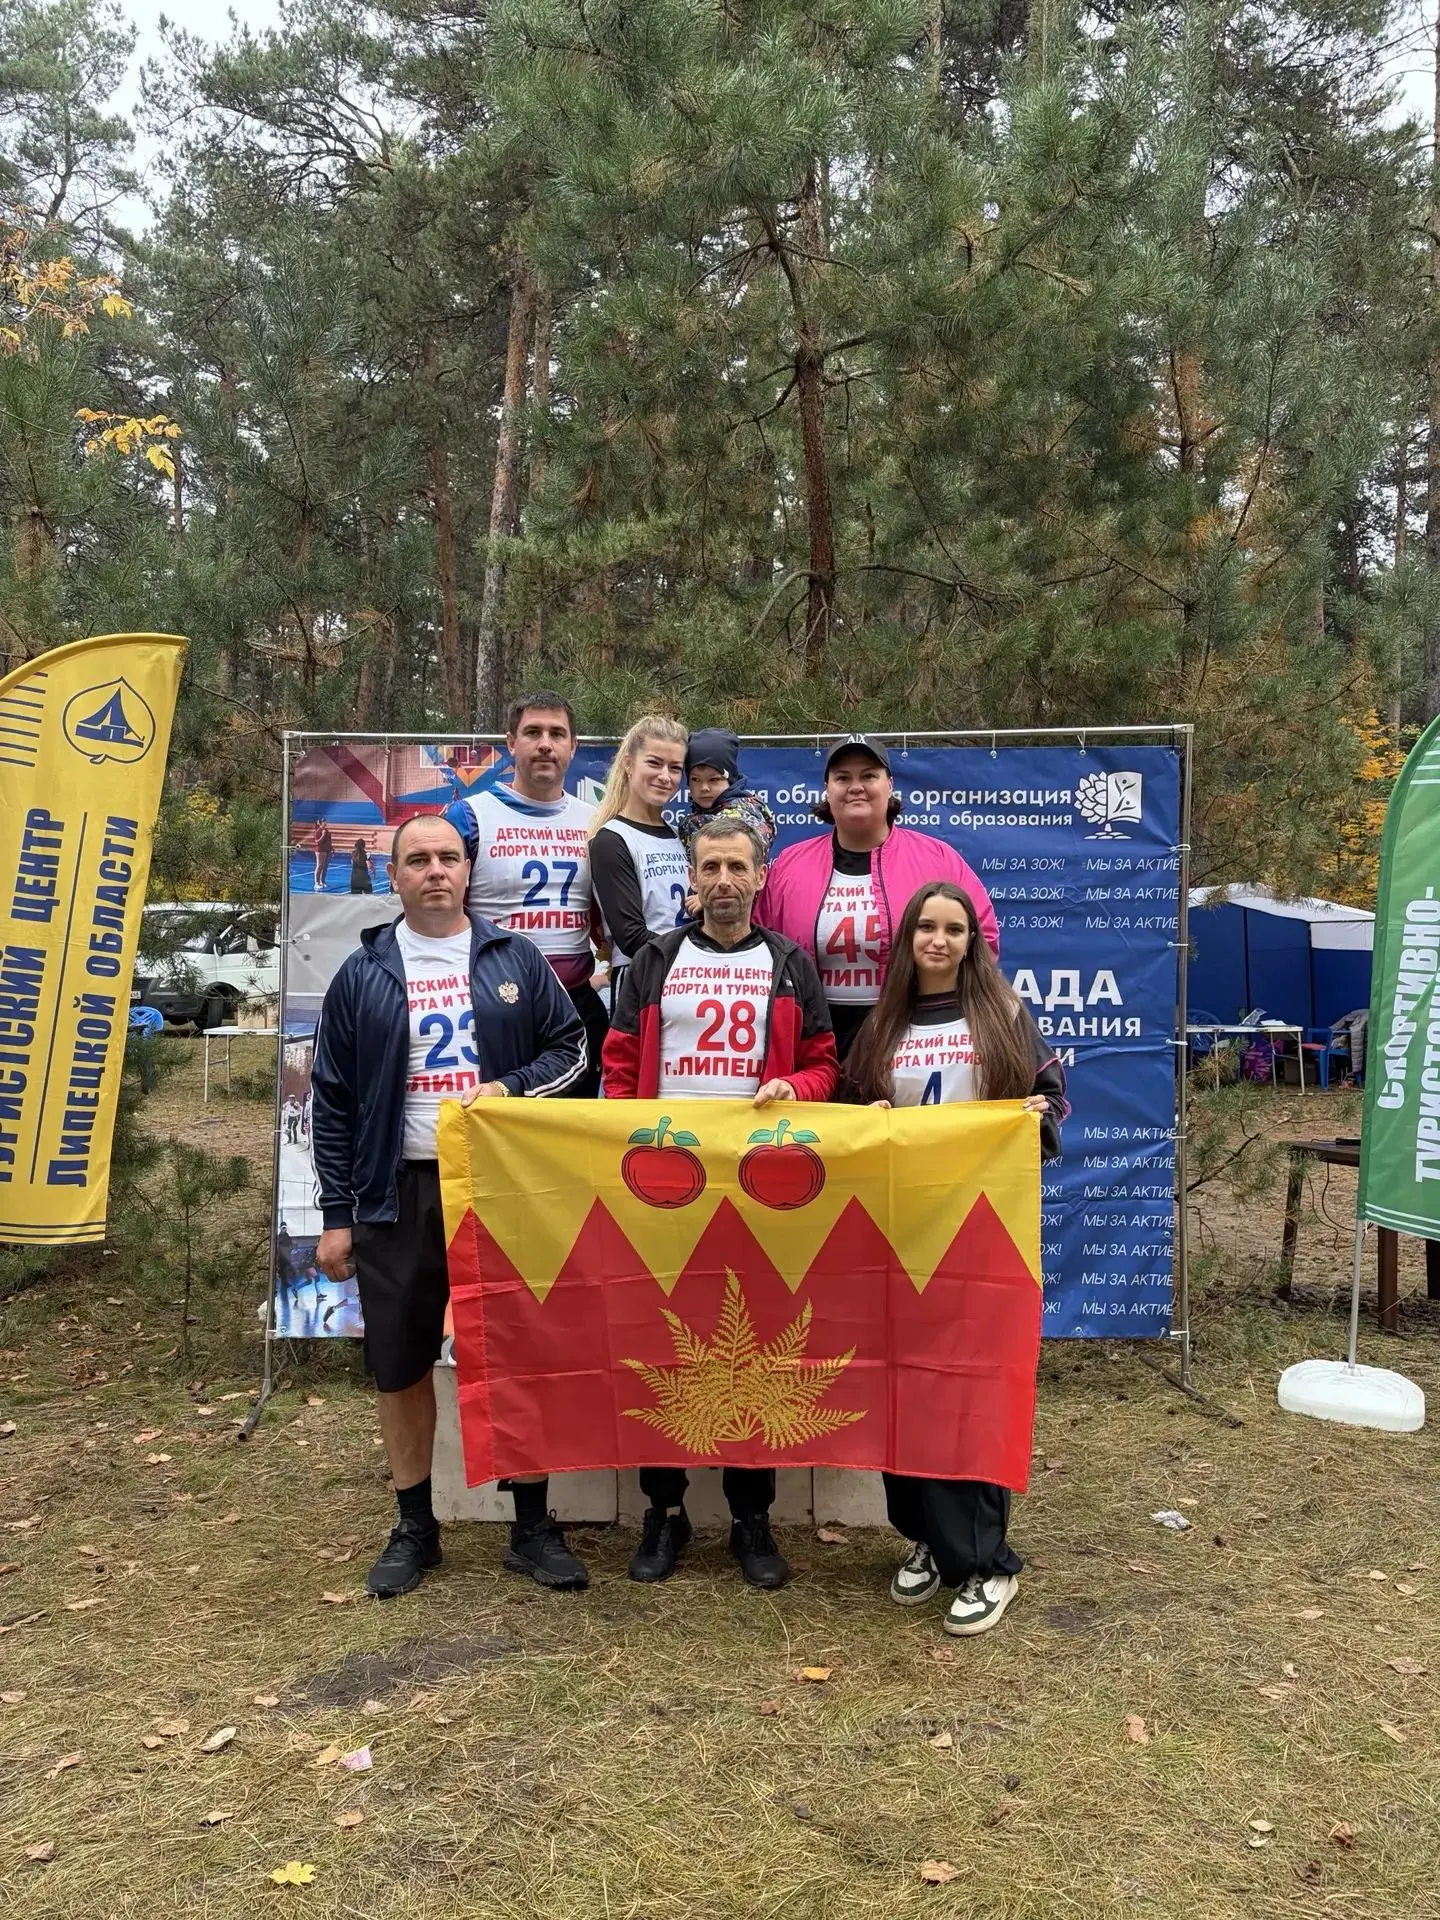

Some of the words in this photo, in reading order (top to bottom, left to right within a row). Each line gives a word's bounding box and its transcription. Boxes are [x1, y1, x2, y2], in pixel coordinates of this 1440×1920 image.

[909, 790, 1072, 811] организация
[950, 811, 1073, 830] образования
[497, 826, 553, 842] ДЕТСКИЙ
[490, 845, 538, 858] СПОРТА
[541, 846, 549, 856] И
[552, 845, 588, 858] ТУРИЗ
[11, 808, 64, 923] ЦЕНТР
[646, 852, 684, 866] ДЕТСКИЙ
[982, 858, 1006, 870] МЫ
[1009, 858, 1026, 870] ЗА
[1030, 858, 1065, 870] ЗОЖ!
[1086, 858, 1111, 870] МЫ
[1114, 858, 1132, 870] ЗА
[644, 865, 678, 879] СПОРТА
[679, 865, 685, 874] И
[522, 860, 578, 907] 27
[86, 816, 138, 977] ОБЛАСТИ
[828, 884, 865, 897] СКИЙ
[1009, 887, 1026, 900] ЗА
[1030, 887, 1064, 900] ЗОЖ!
[1086, 887, 1111, 900] МЫ
[1113, 887, 1131, 900] ЗА
[670, 883, 695, 927] 2
[847, 901, 856, 911] И
[1008, 916, 1026, 929] ЗА
[1029, 916, 1064, 929] ЗОЖ!
[1085, 916, 1110, 929] МЫ
[1113, 916, 1131, 929] ЗА
[826, 915, 881, 963] 45
[670, 965, 730, 981] ДЕТСКИЙ
[408, 974, 459, 994] ТСКИЙ
[662, 983, 709, 997] СПОРТА
[714, 984, 722, 995] И
[442, 995, 453, 1008] И
[696, 999, 756, 1053] 28
[1038, 1017, 1141, 1037] ВАНИЯ
[419, 1010, 480, 1069] 23
[898, 1033, 944, 1051] ТСКИЙ
[925, 1053, 934, 1066] И
[664, 1056, 763, 1078] г.ЛИПЕЦ
[1084, 1127, 1108, 1139] МЫ
[1111, 1127, 1129, 1139] ЗА
[1083, 1156, 1108, 1168] МЫ
[1111, 1157, 1129, 1168] ЗА
[1083, 1185, 1109, 1197] МЫ
[1111, 1186, 1128, 1197] ЗА
[1083, 1214, 1107, 1227] МЫ
[1110, 1215, 1127, 1227] ЗА
[1082, 1243, 1106, 1256] МЫ
[1109, 1244, 1127, 1256] ЗА
[1081, 1272, 1106, 1285] МЫ
[1109, 1273, 1127, 1285] ЗА
[1082, 1302, 1106, 1315] МЫ
[1109, 1303, 1126, 1315] ЗА
